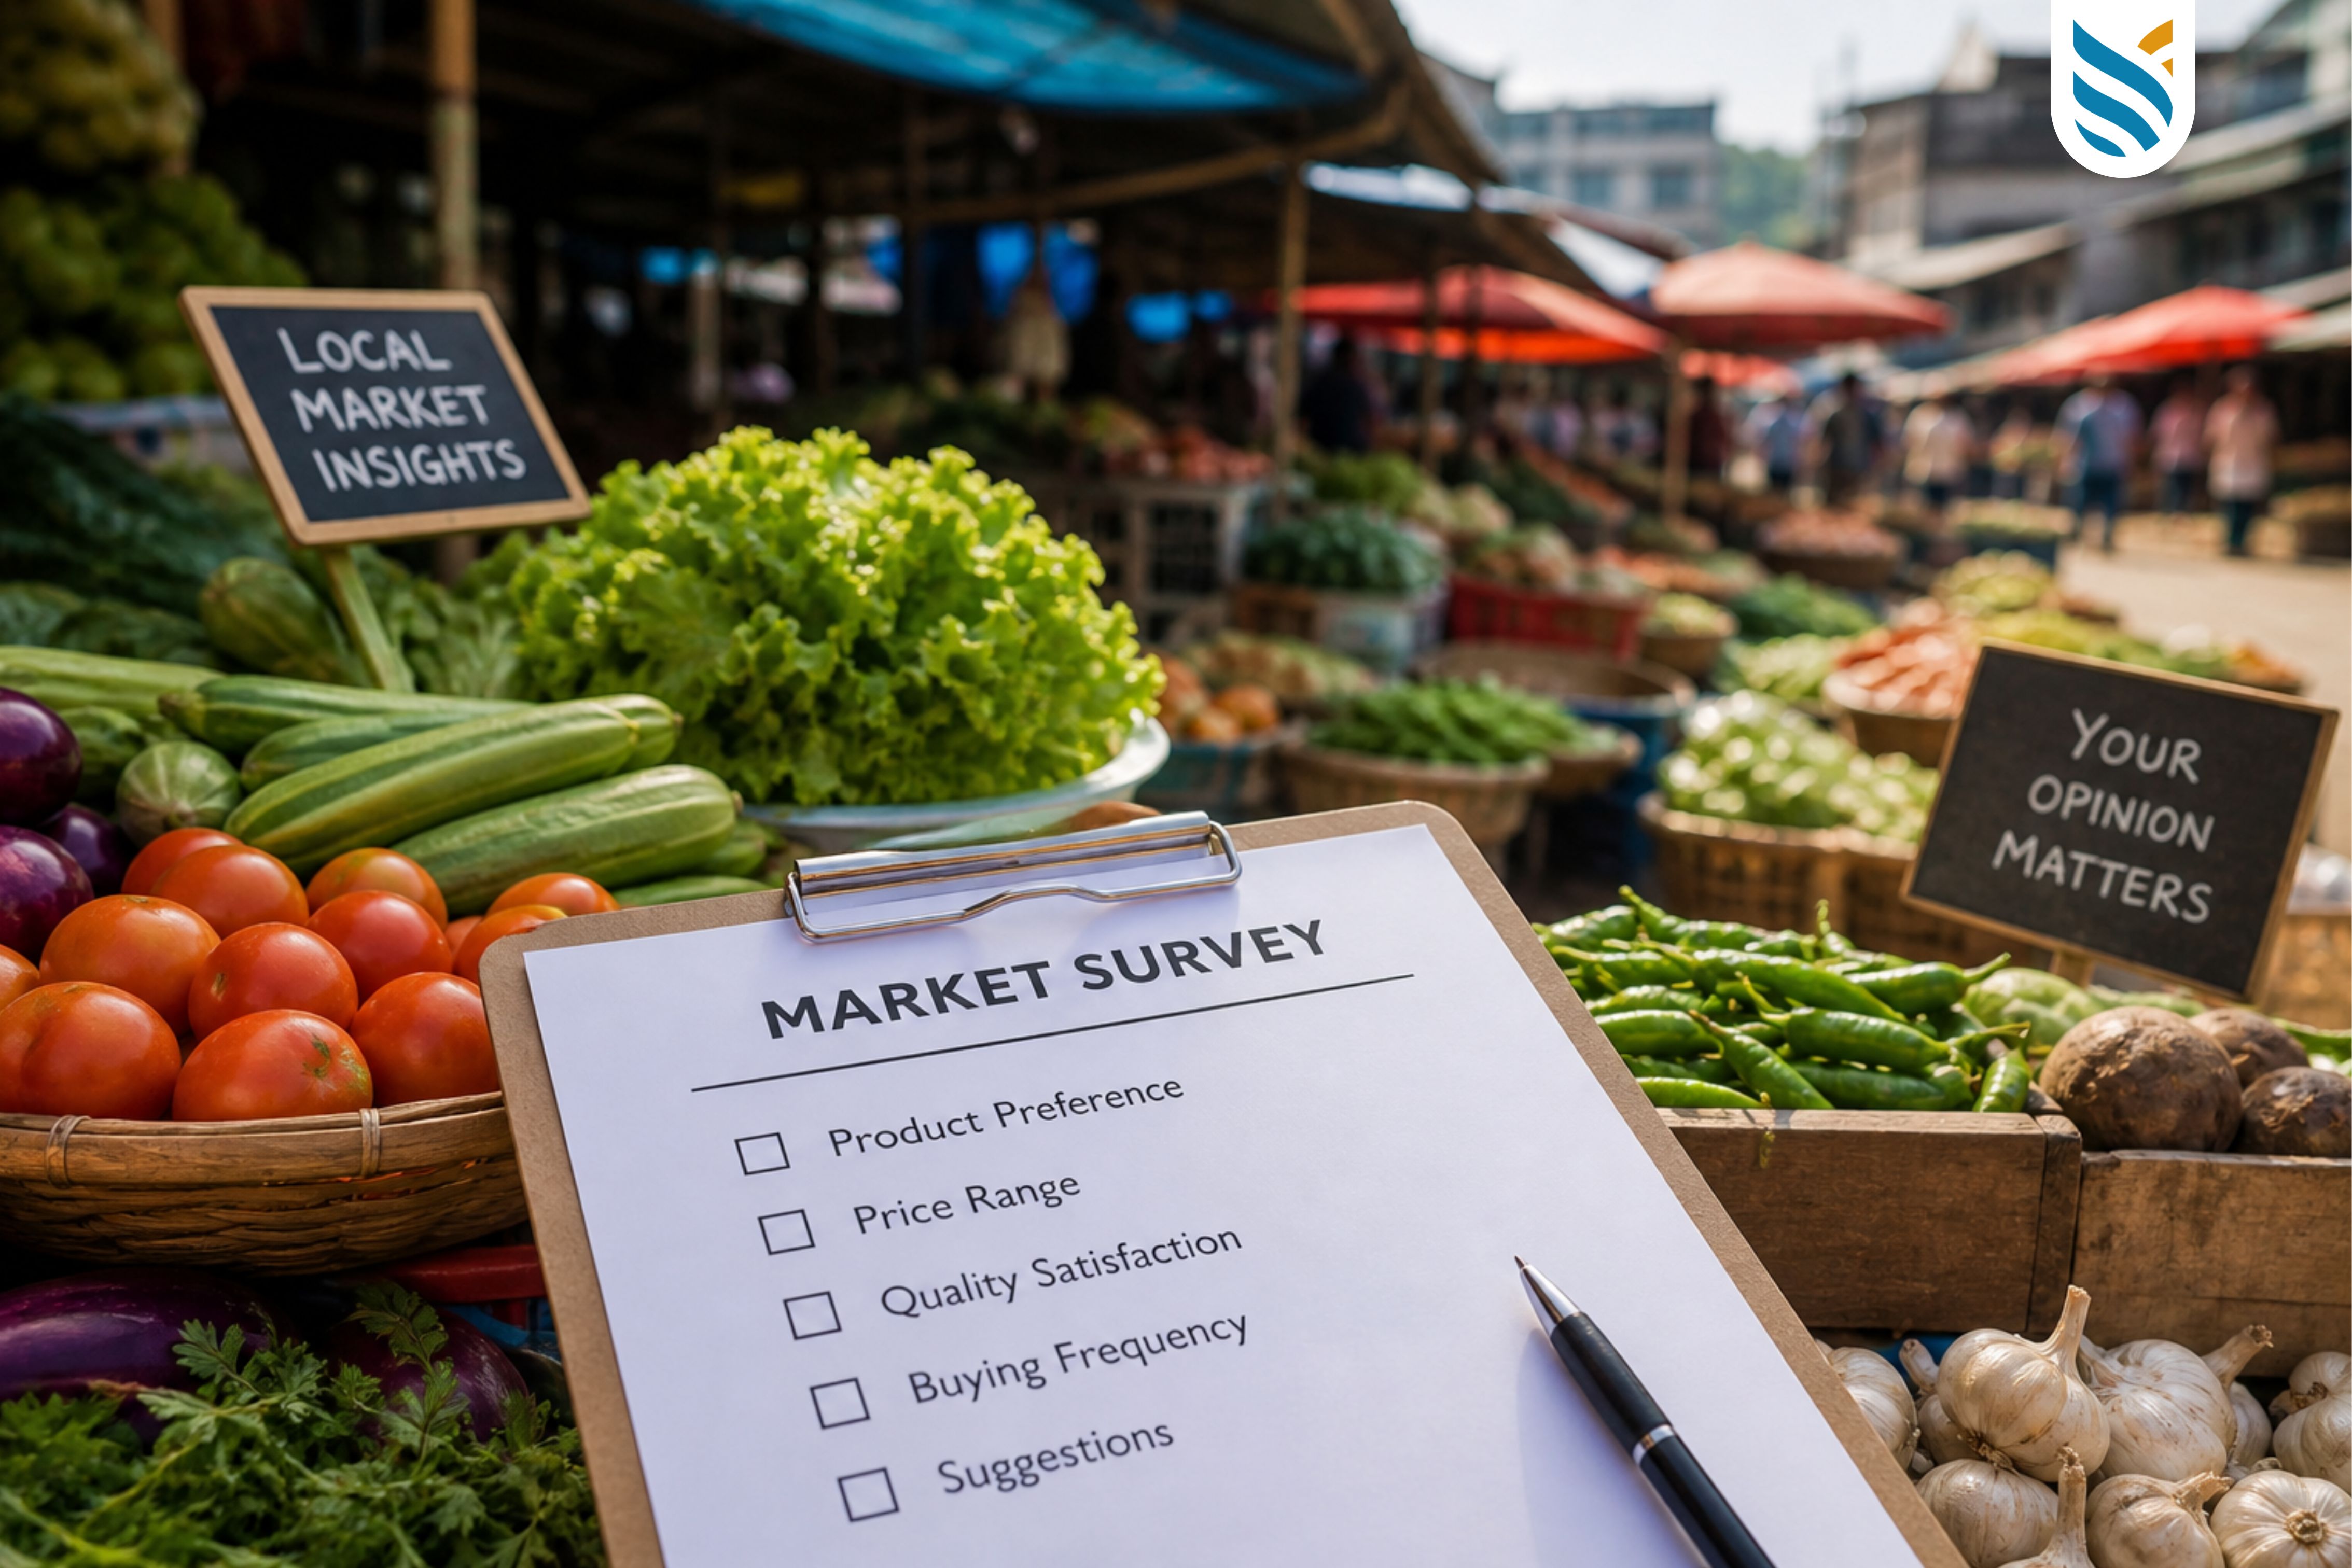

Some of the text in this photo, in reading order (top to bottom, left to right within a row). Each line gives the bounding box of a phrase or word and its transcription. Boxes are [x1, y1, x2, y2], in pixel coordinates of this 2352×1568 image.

[277, 328, 452, 373] LOCAL
[290, 385, 488, 432] MARKET
[312, 439, 525, 491] INSIGHTS
[2071, 708, 2201, 783] YOUR
[2028, 774, 2214, 851] OPINION
[1992, 830, 2212, 923] MATTERS
[761, 919, 1324, 1040] MARKET SURVEY
[828, 1077, 1185, 1157] Product Preference
[853, 1174, 1081, 1235] Price Range
[881, 1227, 1242, 1319] Quality Satisfaction
[908, 1312, 1246, 1404] Buying Frequency
[937, 1422, 1174, 1494] Suggestions
